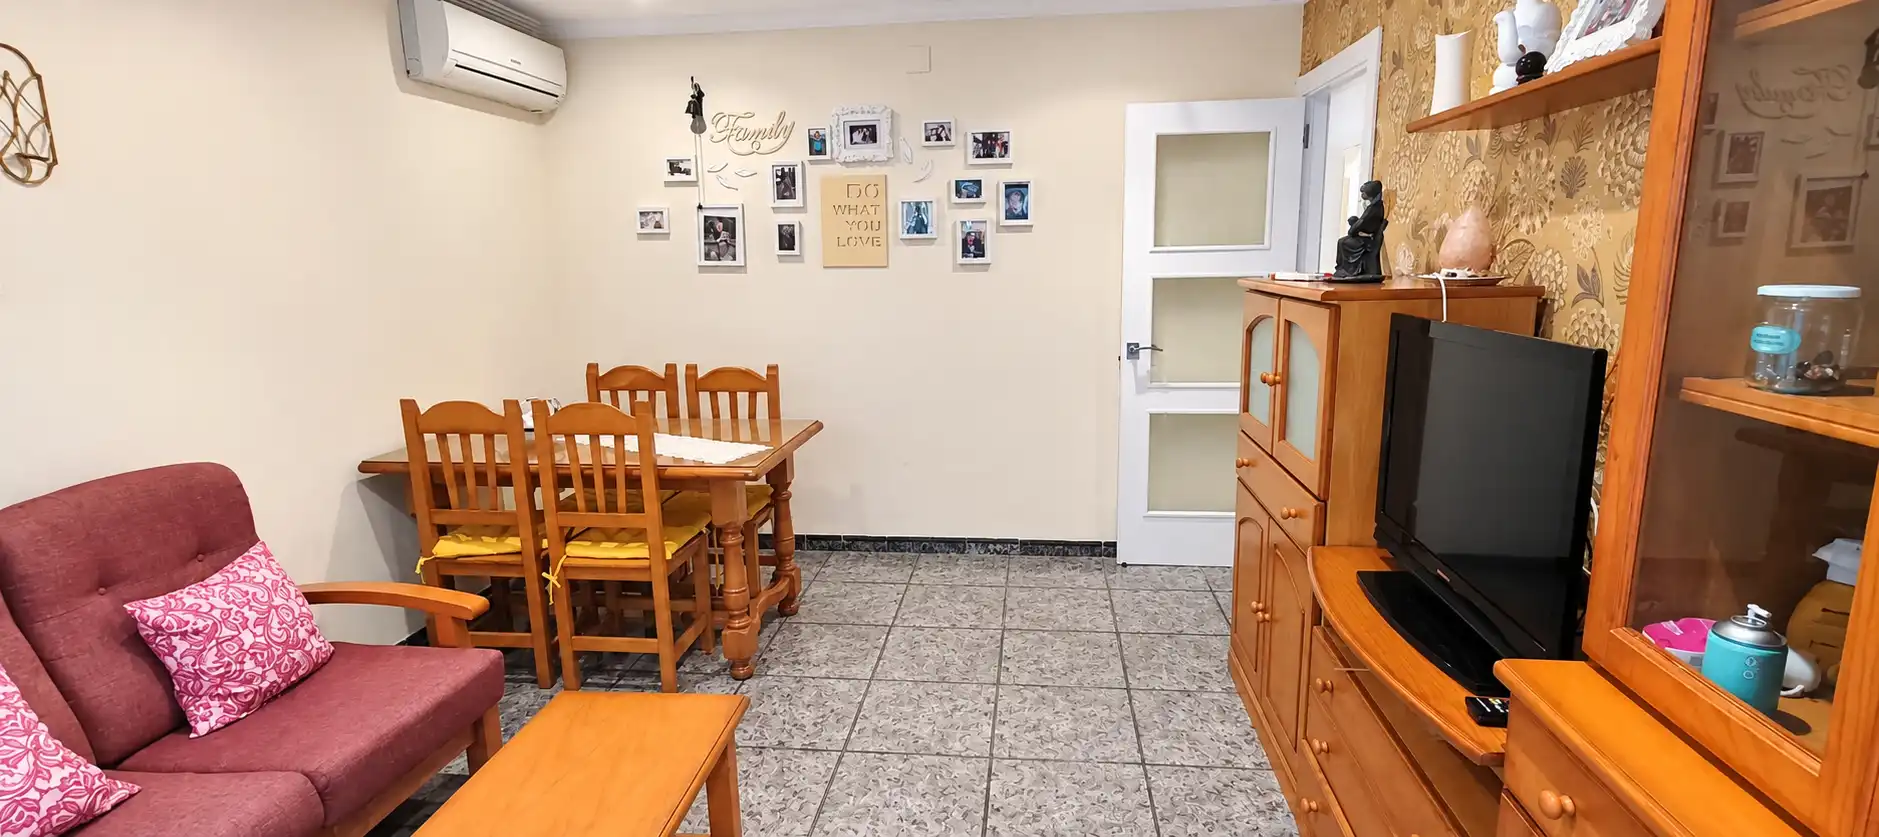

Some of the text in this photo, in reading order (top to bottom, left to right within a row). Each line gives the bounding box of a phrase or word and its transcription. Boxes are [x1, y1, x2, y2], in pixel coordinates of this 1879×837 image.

[709, 110, 796, 157] Family
[846, 183, 880, 199] DO
[832, 204, 881, 216] WHAT
[845, 220, 882, 232] YOU
[836, 236, 882, 248] LOVE
